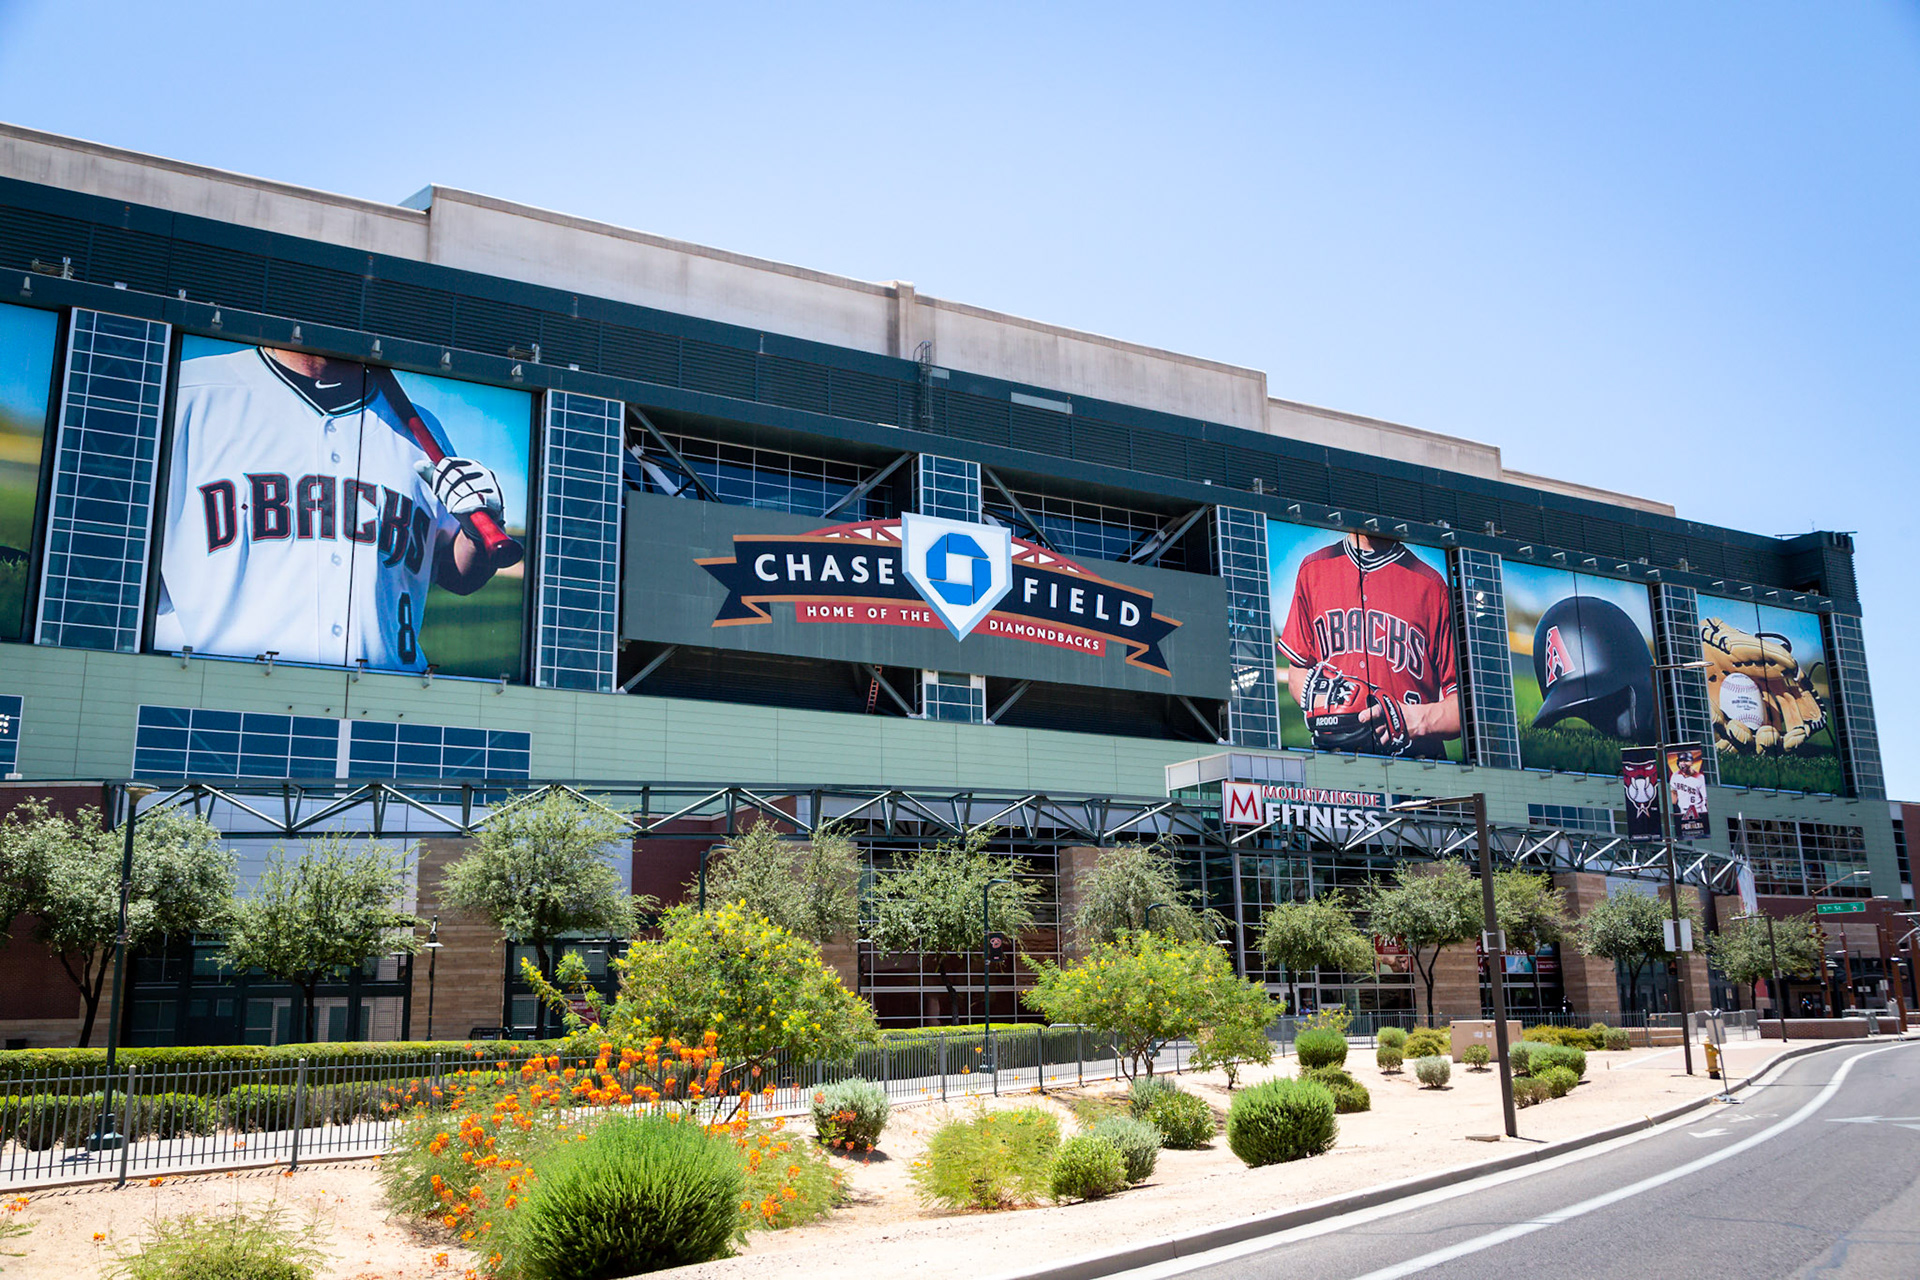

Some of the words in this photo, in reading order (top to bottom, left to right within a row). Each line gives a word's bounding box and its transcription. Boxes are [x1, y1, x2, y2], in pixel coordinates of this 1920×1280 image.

[754, 553, 895, 585] CHASE
[1023, 577, 1141, 627] FIELD
[397, 592, 416, 665] 8
[807, 606, 855, 618] HOME
[868, 607, 888, 619] OF
[900, 609, 930, 622] THE
[989, 619, 1100, 650] DIAMONDBACKS
[1546, 625, 1576, 688] A
[1316, 716, 1338, 727] A2000
[1229, 789, 1259, 821] M
[1263, 785, 1381, 807] MOUNTAINSIDE
[1265, 802, 1382, 831] FITNESS
